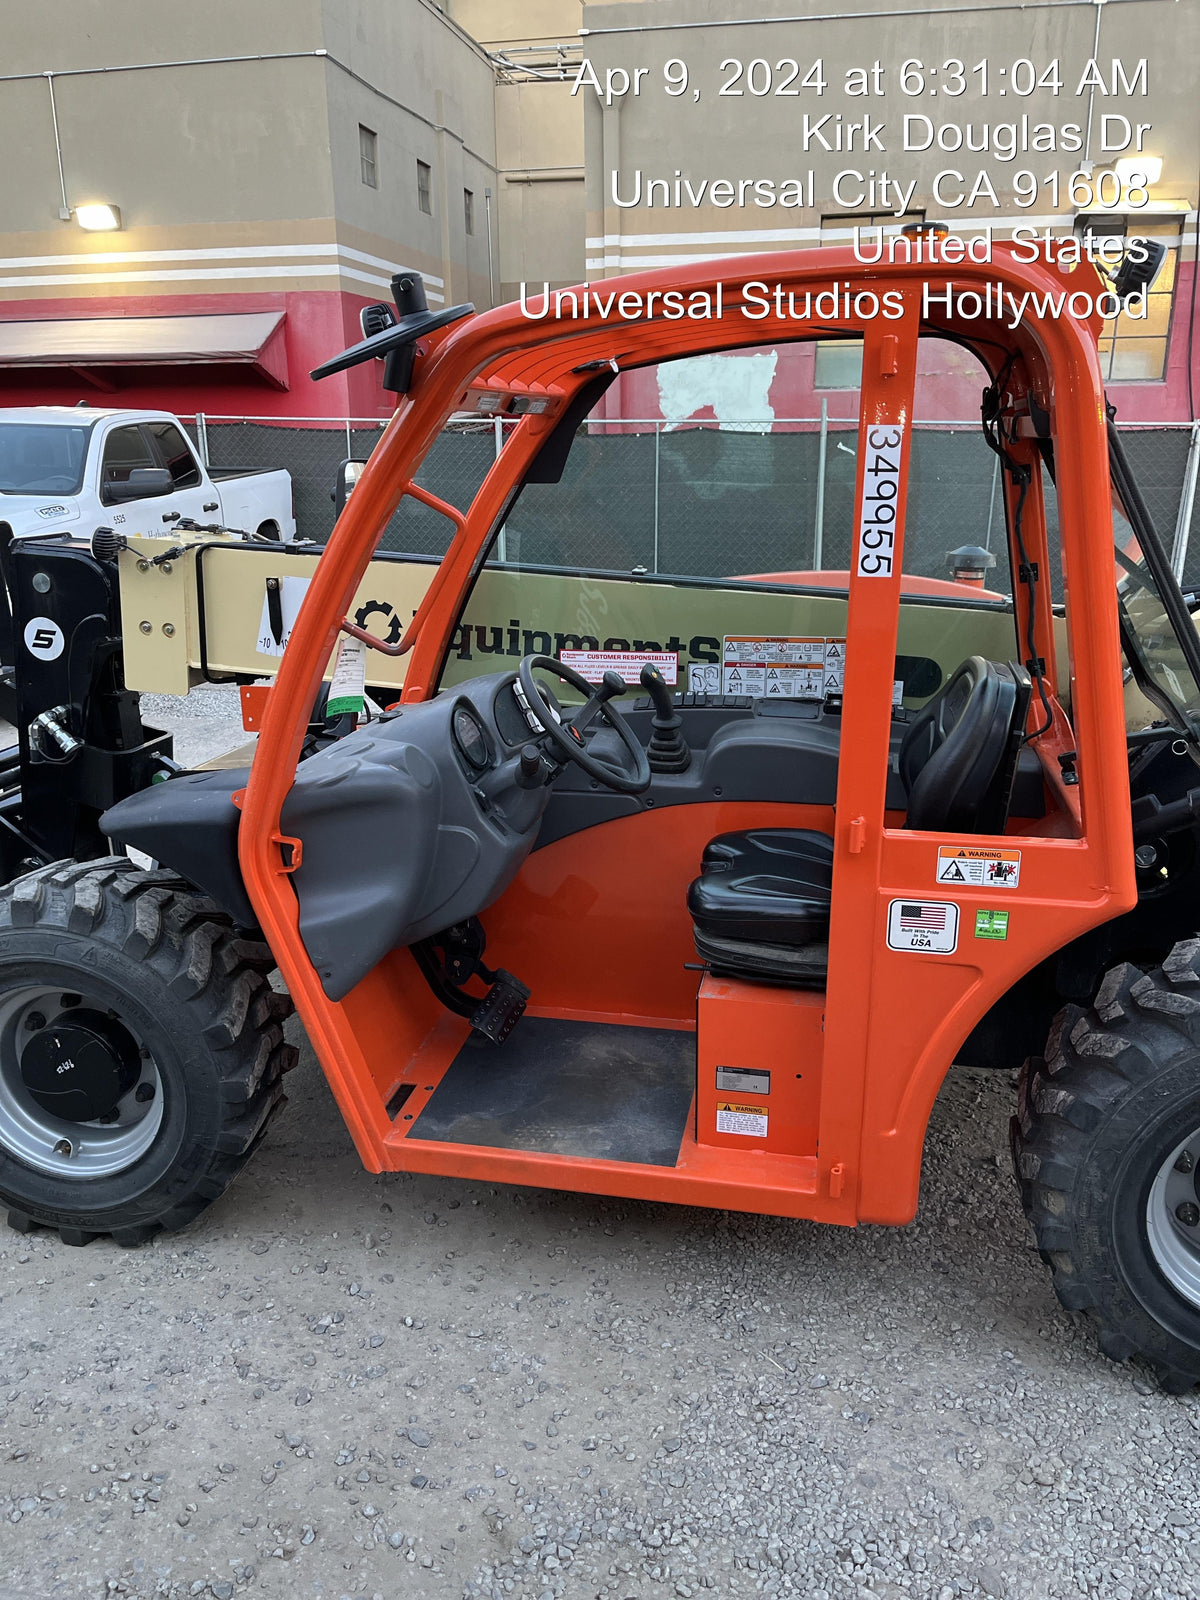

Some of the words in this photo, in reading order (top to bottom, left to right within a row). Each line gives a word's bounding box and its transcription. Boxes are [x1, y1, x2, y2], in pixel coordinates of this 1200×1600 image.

[860, 429, 902, 574] 349955
[587, 653, 621, 661] CUSTOMER
[622, 654, 676, 662] RESPONSIBILITY
[968, 850, 1002, 859] WARNING
[910, 938, 932, 948] USA
[734, 1106, 763, 1114] WARNING
